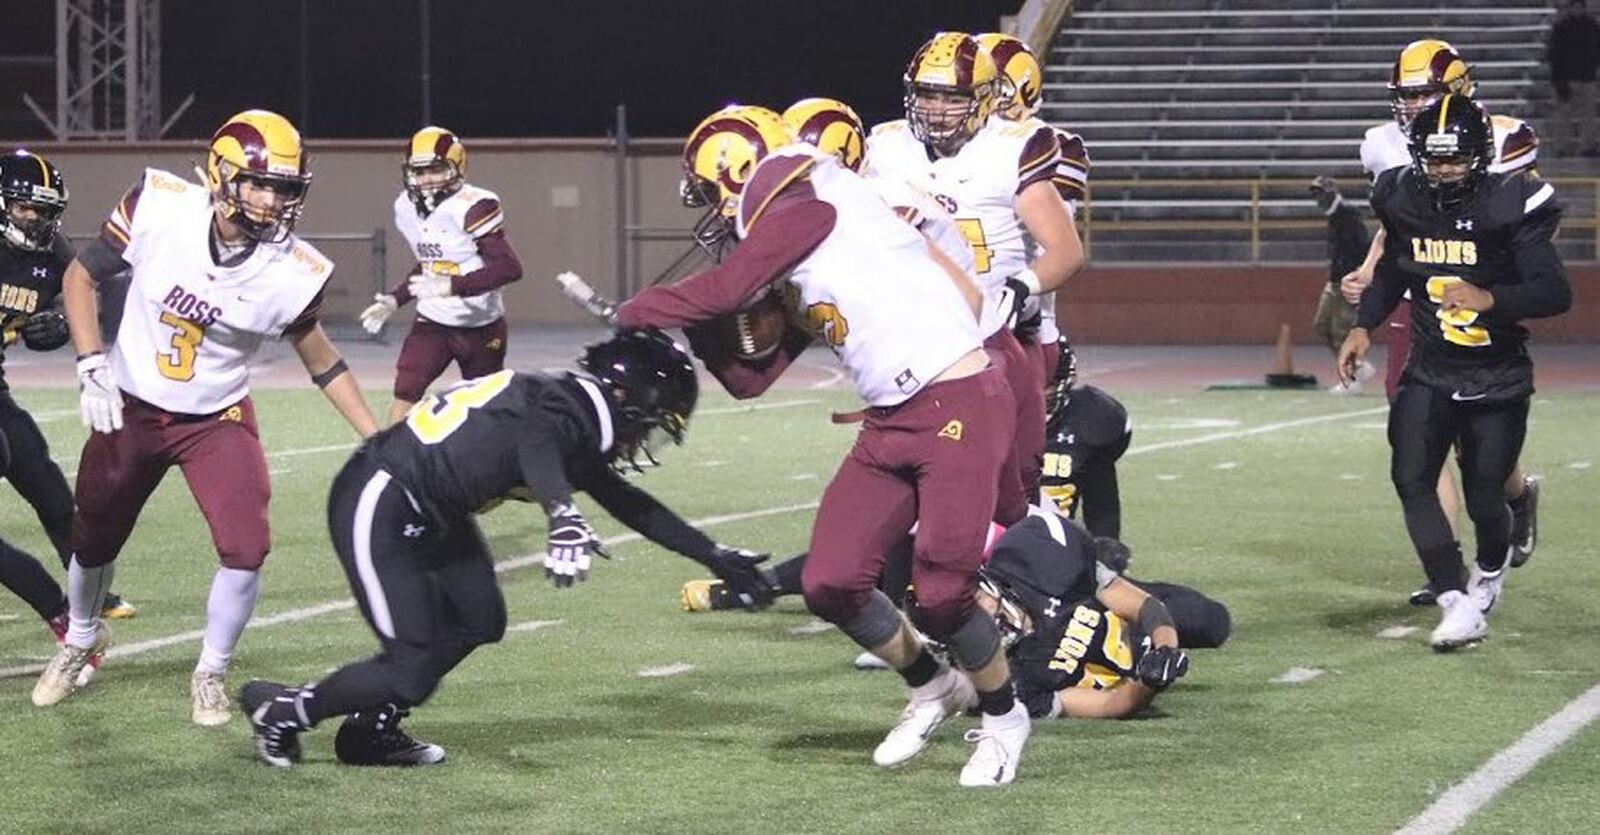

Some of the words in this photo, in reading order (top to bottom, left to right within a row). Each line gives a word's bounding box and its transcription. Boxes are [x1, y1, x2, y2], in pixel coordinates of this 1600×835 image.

[1411, 237, 1478, 265] LIONS
[163, 284, 223, 328] ROSS
[156, 310, 206, 383] 3
[1047, 604, 1101, 675] LIONS
